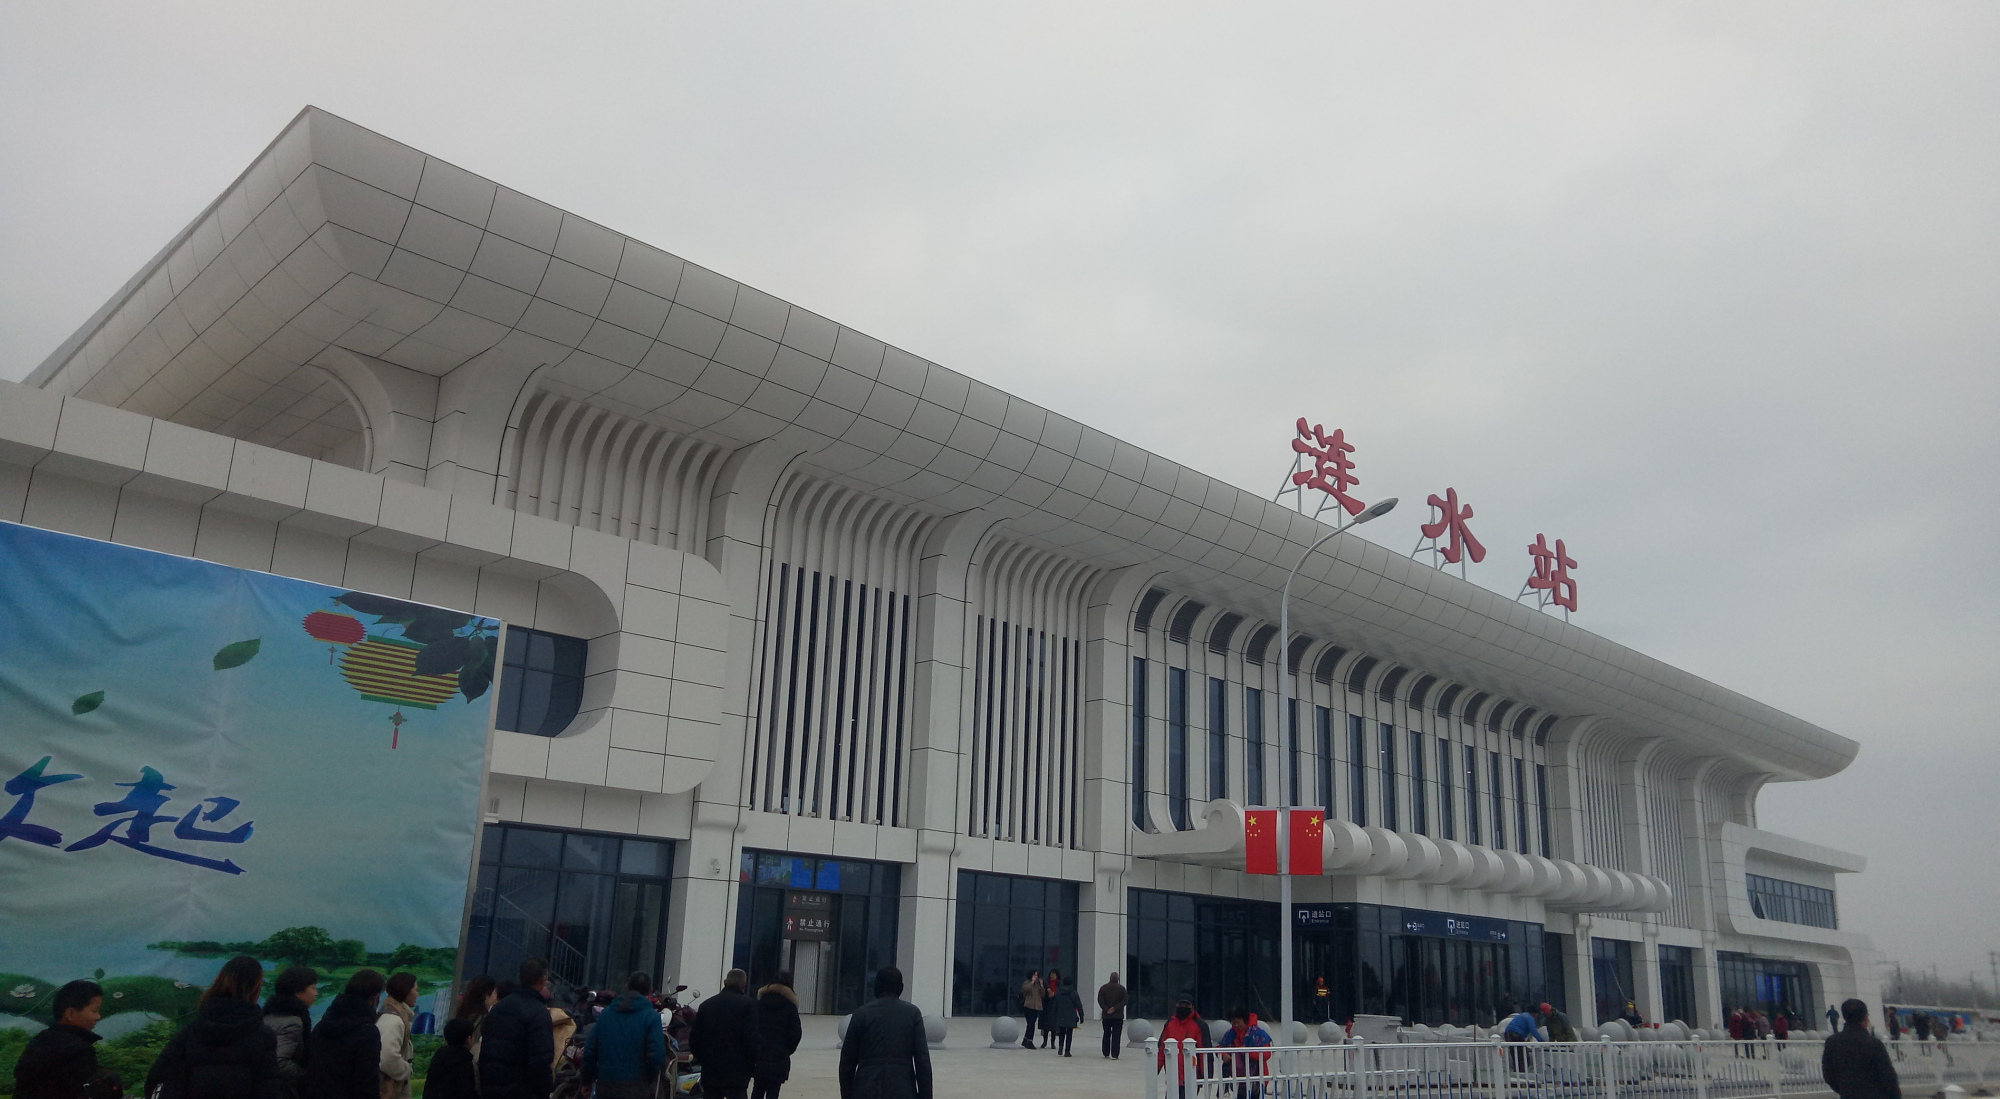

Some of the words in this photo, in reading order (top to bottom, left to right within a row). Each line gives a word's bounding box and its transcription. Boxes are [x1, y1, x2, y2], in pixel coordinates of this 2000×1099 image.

[1292, 417, 1577, 612] 涟水站
[1311, 910, 1332, 919] 进站口
[799, 918, 830, 929] 禁止通行
